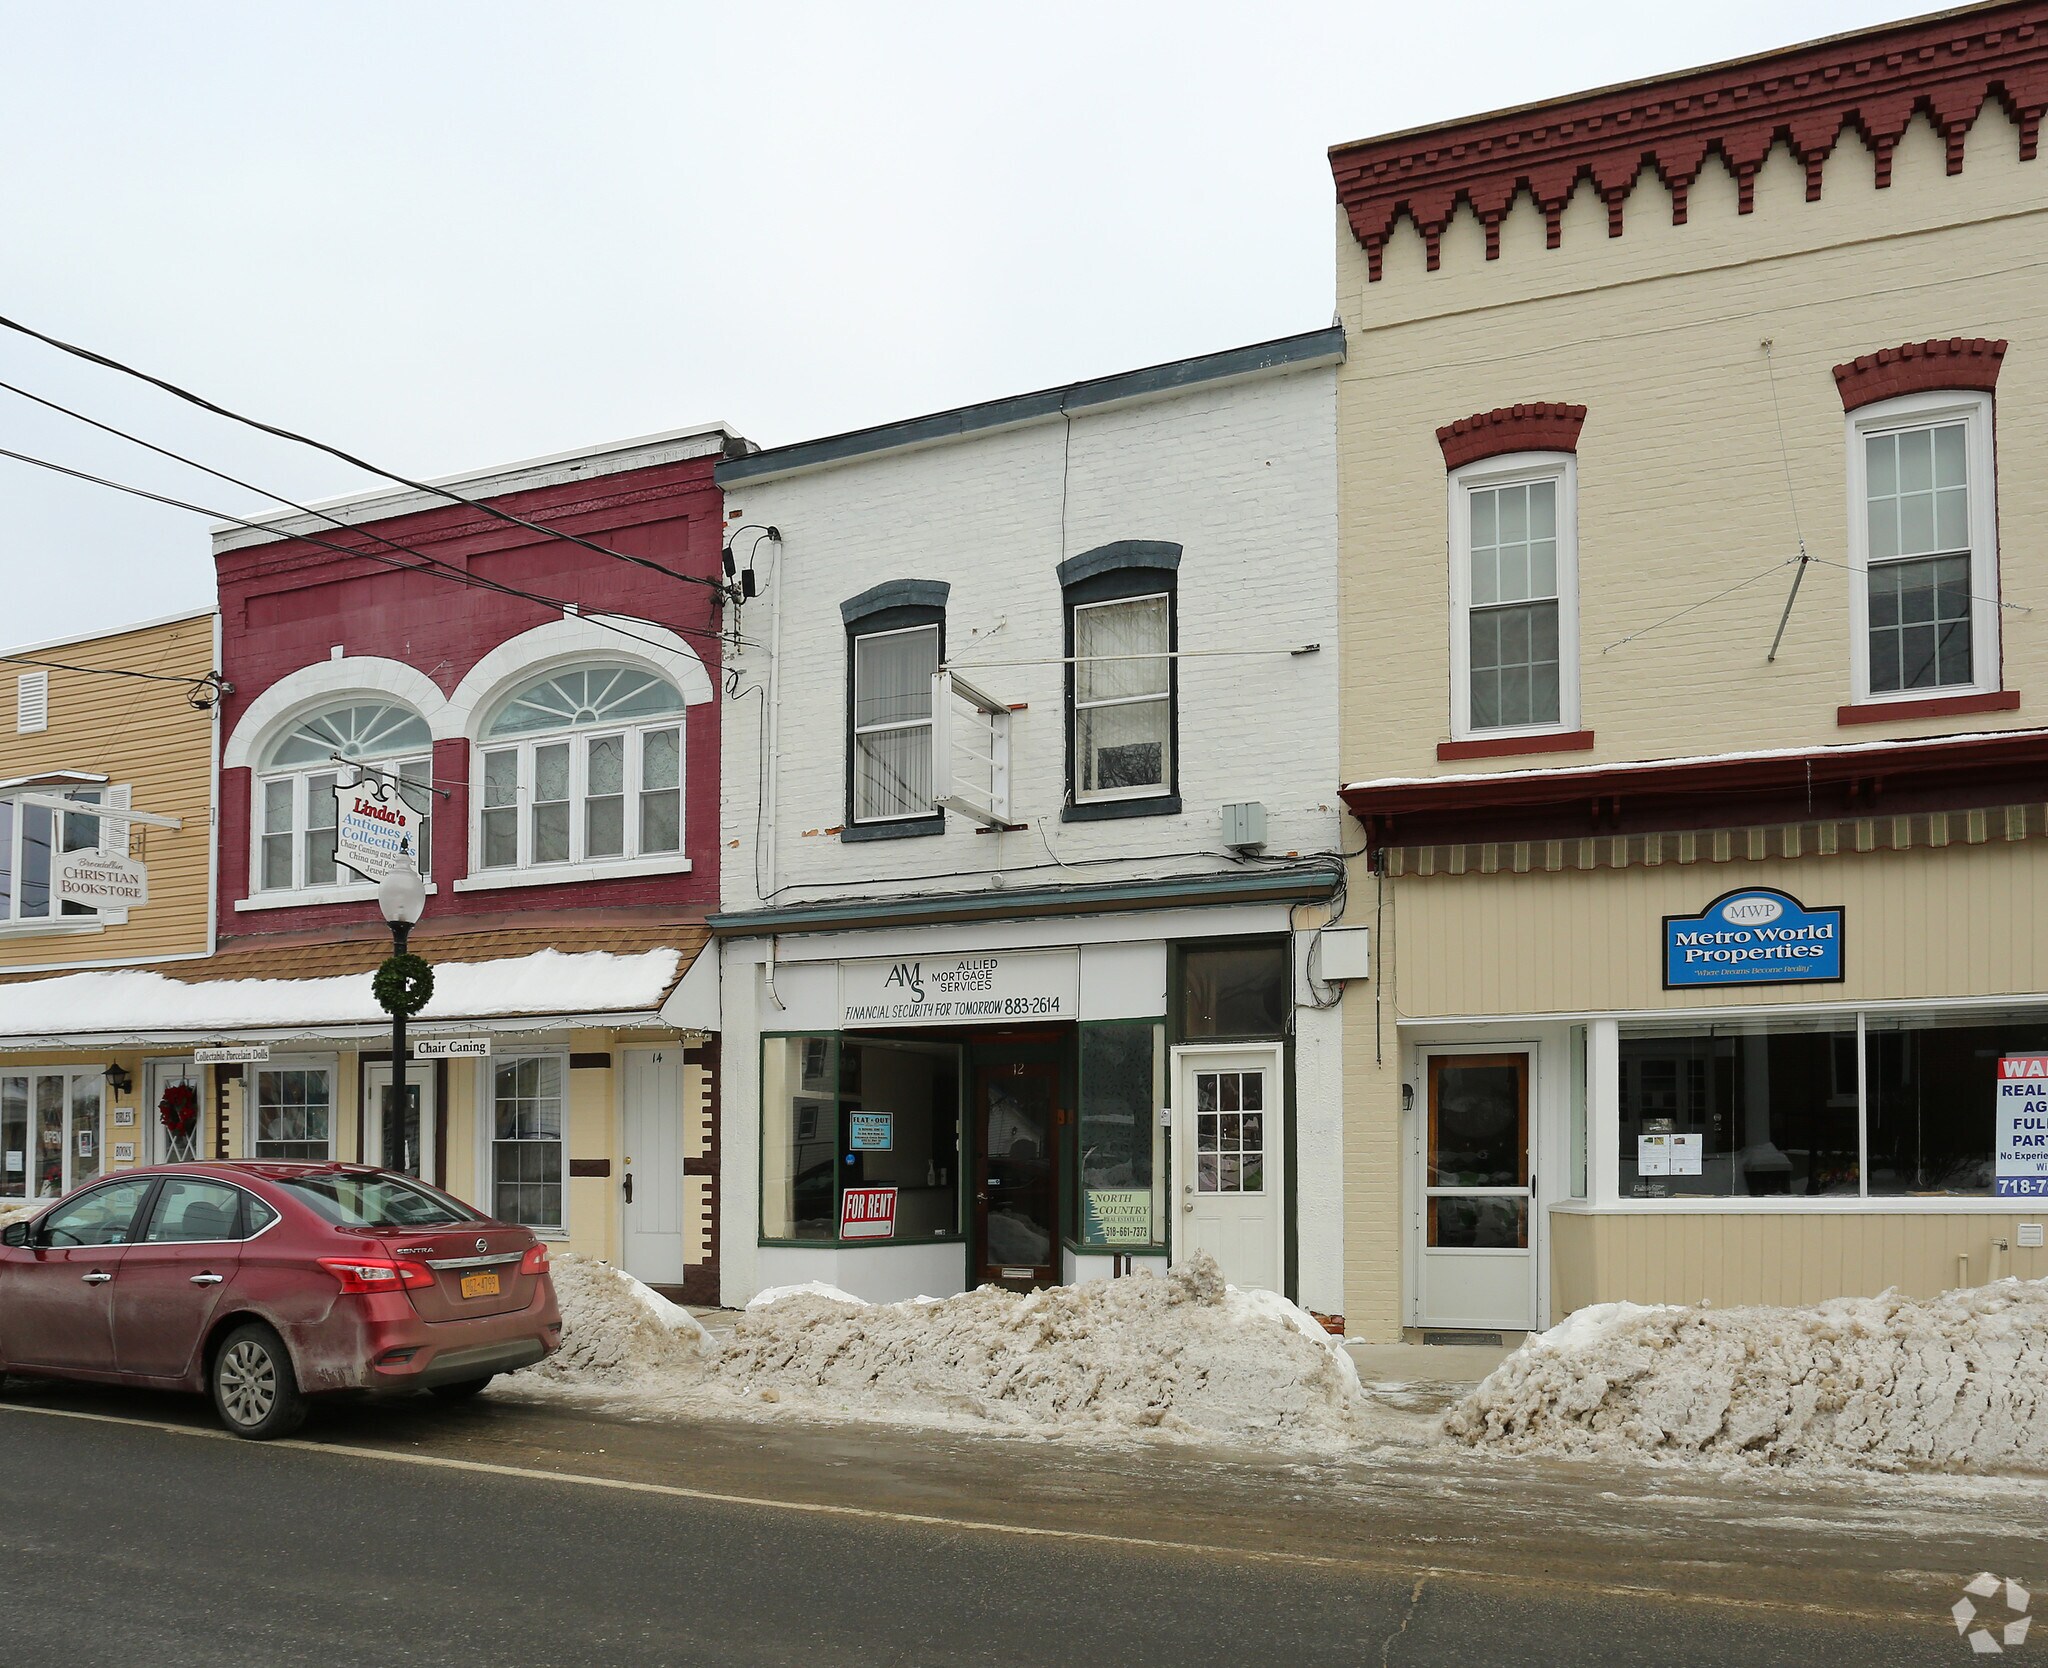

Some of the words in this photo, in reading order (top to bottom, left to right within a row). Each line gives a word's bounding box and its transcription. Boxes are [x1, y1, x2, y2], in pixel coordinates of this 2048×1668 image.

[353, 797, 407, 827] Linda's
[342, 813, 400, 839] Antiques
[405, 830, 414, 842] &
[342, 826, 416, 857] Collectibs
[349, 851, 369, 864] China
[370, 858, 383, 867] and
[380, 851, 392, 860] and
[63, 867, 139, 884] CHRISTIAN
[365, 865, 389, 877] Jewelr
[61, 880, 142, 898] BOOKSTORE
[1730, 904, 1775, 919] MWP
[1676, 931, 1751, 946] Metro
[1754, 923, 1833, 942] World
[1685, 943, 1824, 964] Properties
[957, 958, 998, 971] ALLIED
[931, 970, 993, 982] MORTGAGE
[940, 980, 992, 992] SERVICES
[845, 1004, 890, 1020] FINANCIAL
[892, 1003, 934, 1018] SECURITY
[935, 1002, 951, 1016] FOR
[954, 1000, 1004, 1016] TOMORROW
[1004, 997, 1060, 1015] 883-2614
[418, 1041, 446, 1053] Chair
[449, 1040, 486, 1055] Caning
[196, 1051, 225, 1061] Collectable
[227, 1049, 251, 1060] Porcelain
[253, 1049, 268, 1059] Dolls
[653, 1052, 663, 1063] 14
[1013, 1063, 1025, 1075] 12
[2003, 1060, 2048, 1078] WA
[2002, 1084, 2046, 1096] REAL
[2023, 1101, 2048, 1113] AG
[116, 1112, 131, 1123] BIBLES
[2014, 1118, 2048, 1130] FUL
[44, 1131, 62, 1143] OPEN
[2013, 1135, 2048, 1147] PAR
[116, 1146, 131, 1157] BOOKS
[2000, 1152, 2012, 1160] No
[2015, 1152, 2048, 1162] Experie
[2036, 1163, 2048, 1172] Wi
[1999, 1179, 2048, 1194] 718-7
[1095, 1194, 1132, 1203] NORTH
[846, 1194, 865, 1219] FOR
[867, 1193, 893, 1218] RENT
[1099, 1206, 1149, 1215] COUNTRY
[1106, 1227, 1147, 1237] 518-661-7373
[397, 1247, 434, 1255] SENTRA
